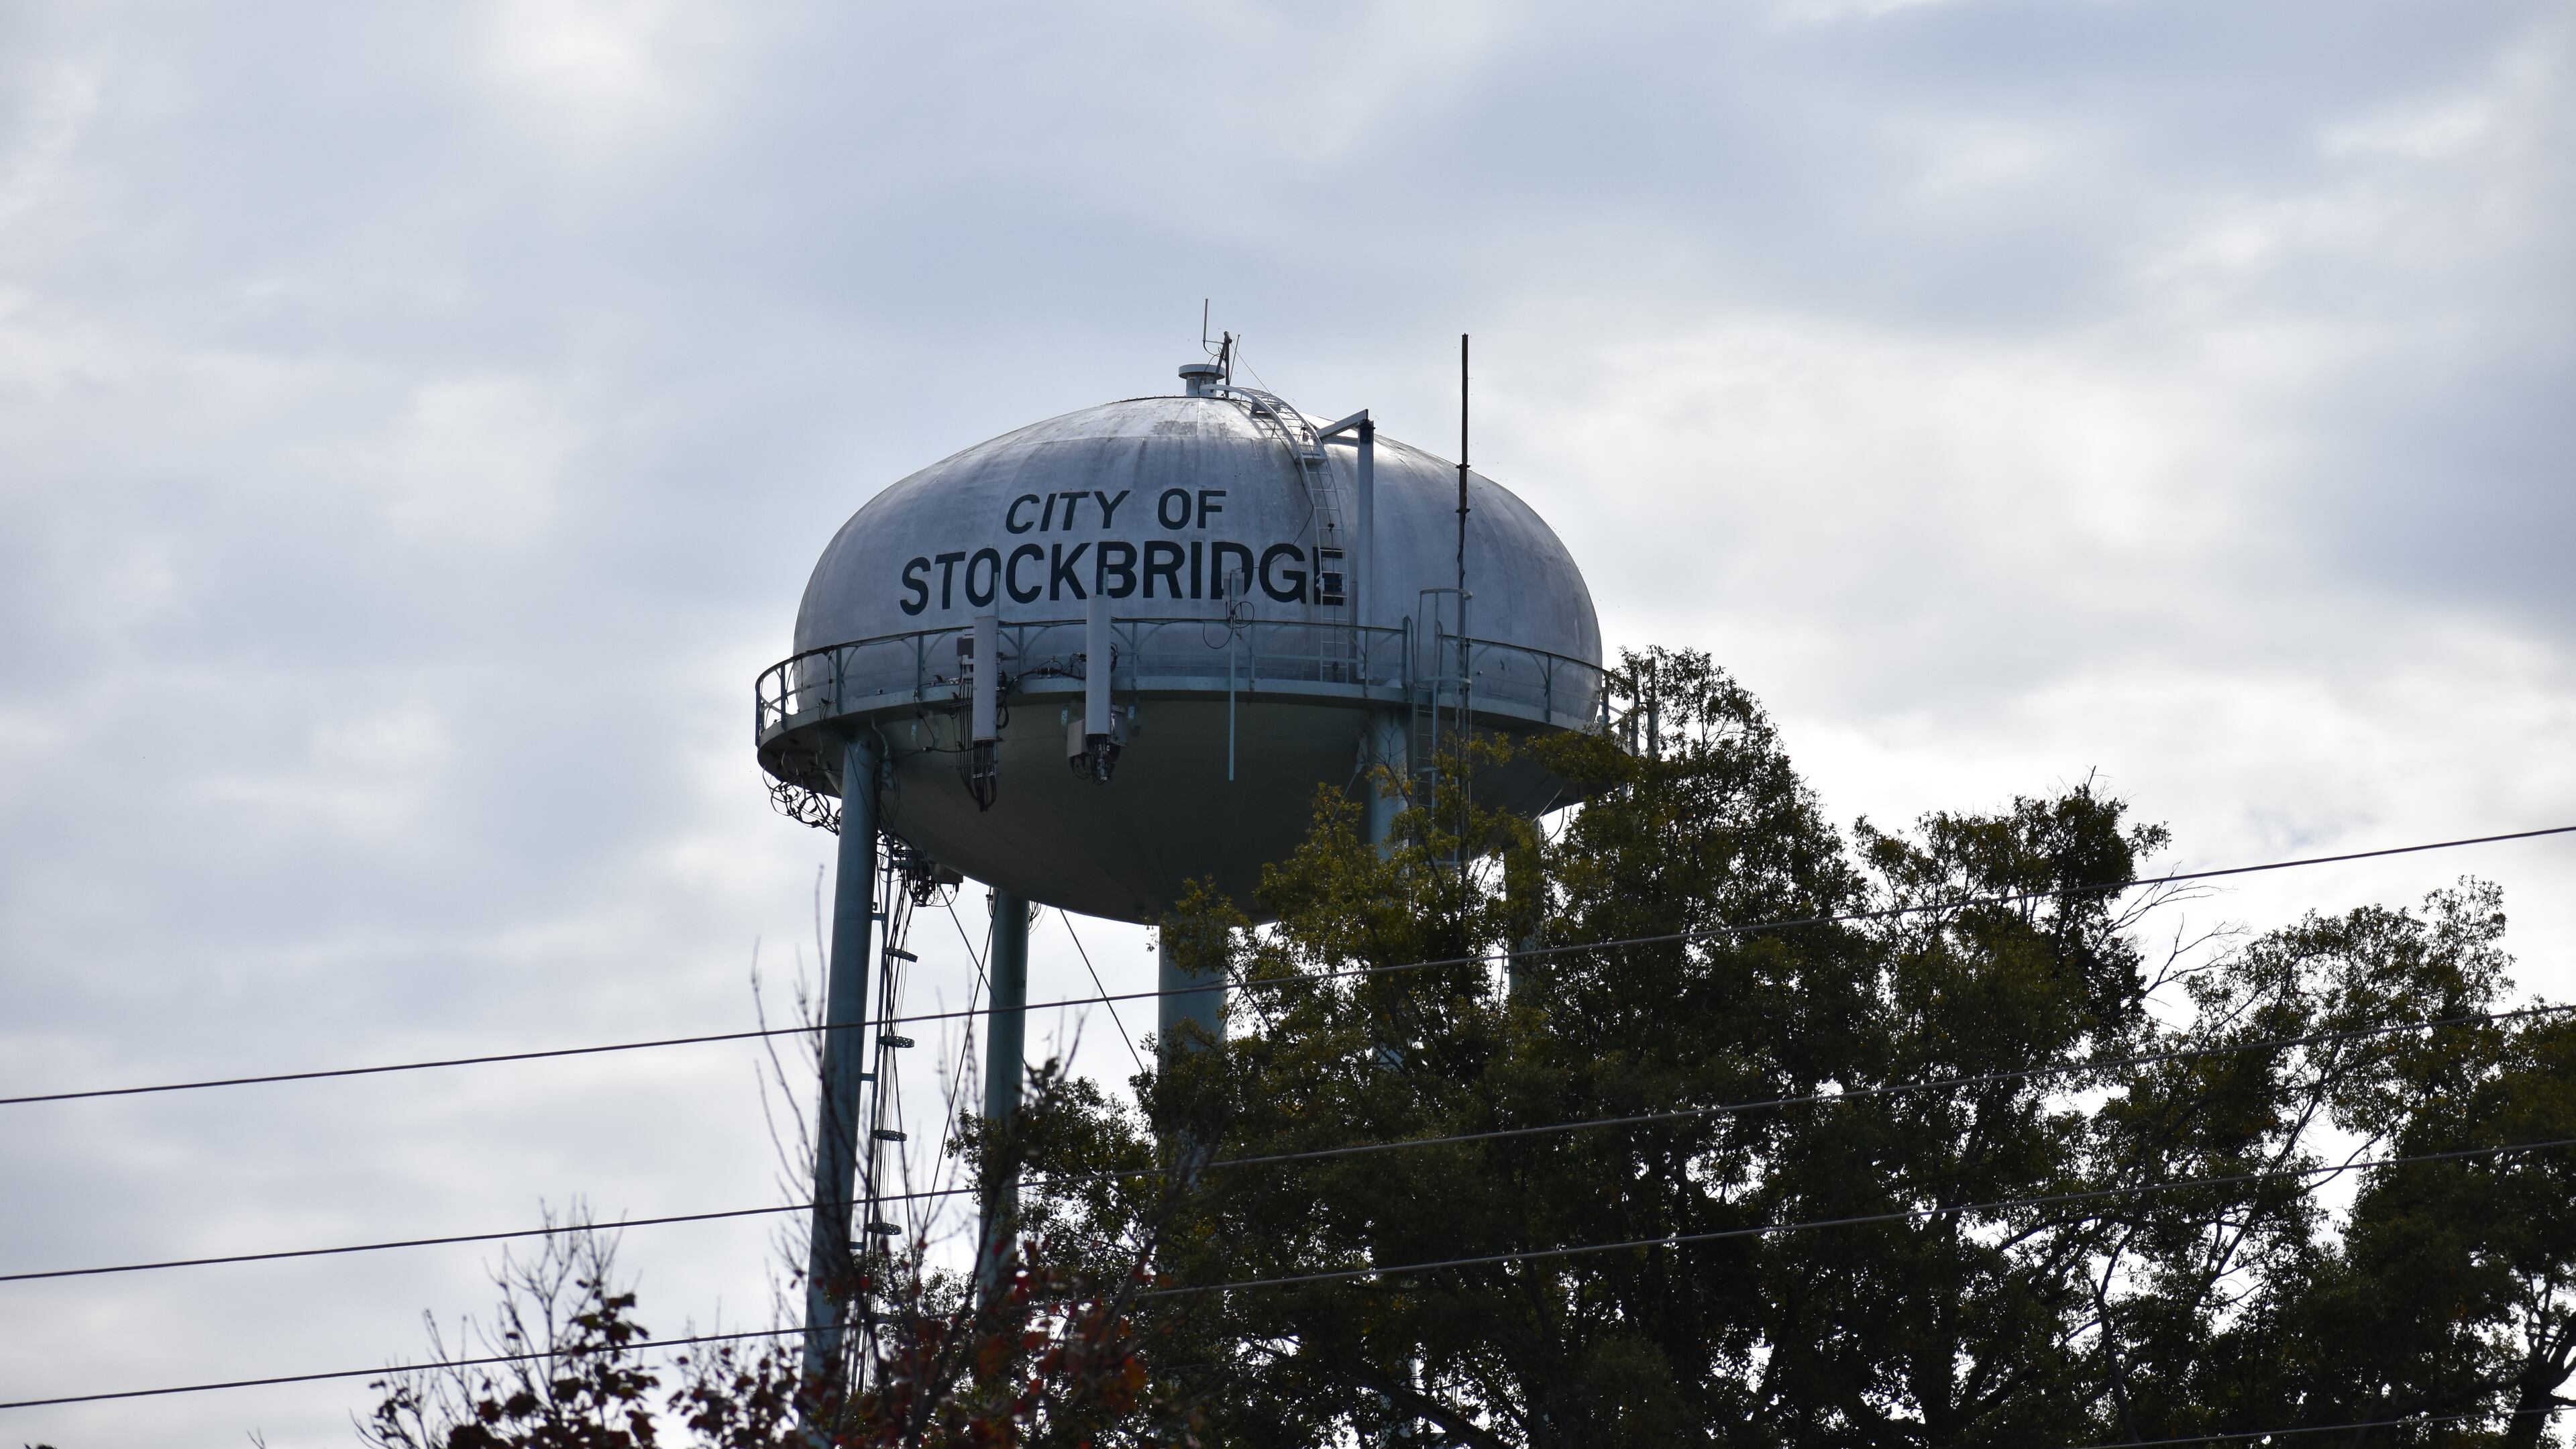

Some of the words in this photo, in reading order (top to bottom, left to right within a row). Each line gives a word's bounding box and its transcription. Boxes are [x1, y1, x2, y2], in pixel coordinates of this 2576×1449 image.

[1006, 490, 1131, 534] CITY
[1157, 488, 1226, 531] OF
[900, 541, 1344, 616] STOCKBRIDGE
